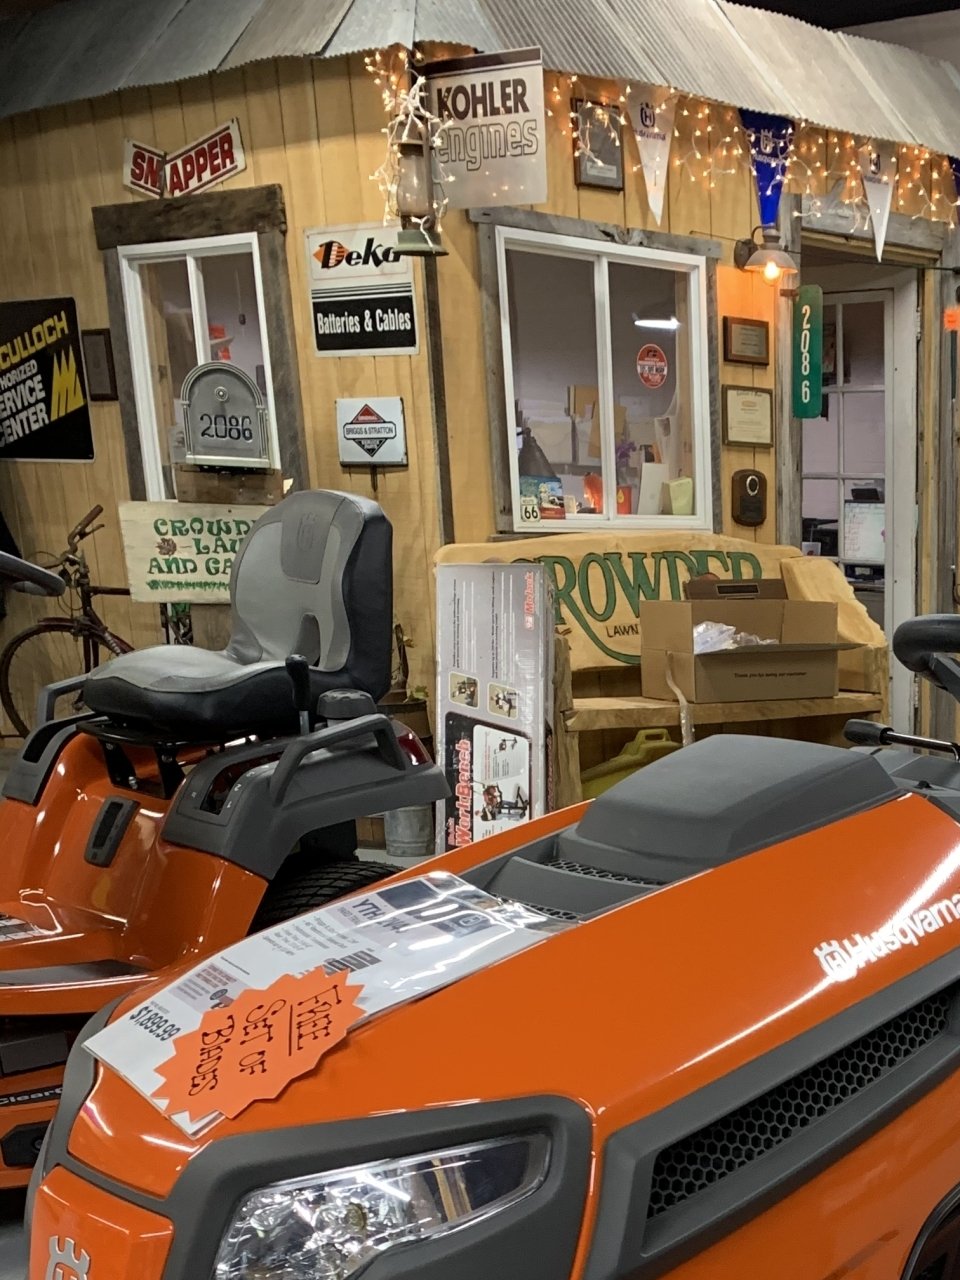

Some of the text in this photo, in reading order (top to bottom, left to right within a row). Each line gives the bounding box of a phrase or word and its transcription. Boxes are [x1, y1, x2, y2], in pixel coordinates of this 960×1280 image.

[437, 78, 530, 121] KOHLER
[436, 119, 539, 172] engines
[316, 307, 412, 335] Batteries & Cables
[200, 413, 254, 442] 2086
[345, 427, 363, 435] BRIGGS
[368, 426, 393, 435] STRATTON
[153, 517, 256, 537] CROWD
[524, 506, 538, 520] 66
[147, 557, 198, 575] AND
[129, 1005, 184, 1042] $1,899.99
[296, 984, 343, 1051] FREE
[238, 998, 287, 1076] SET OF
